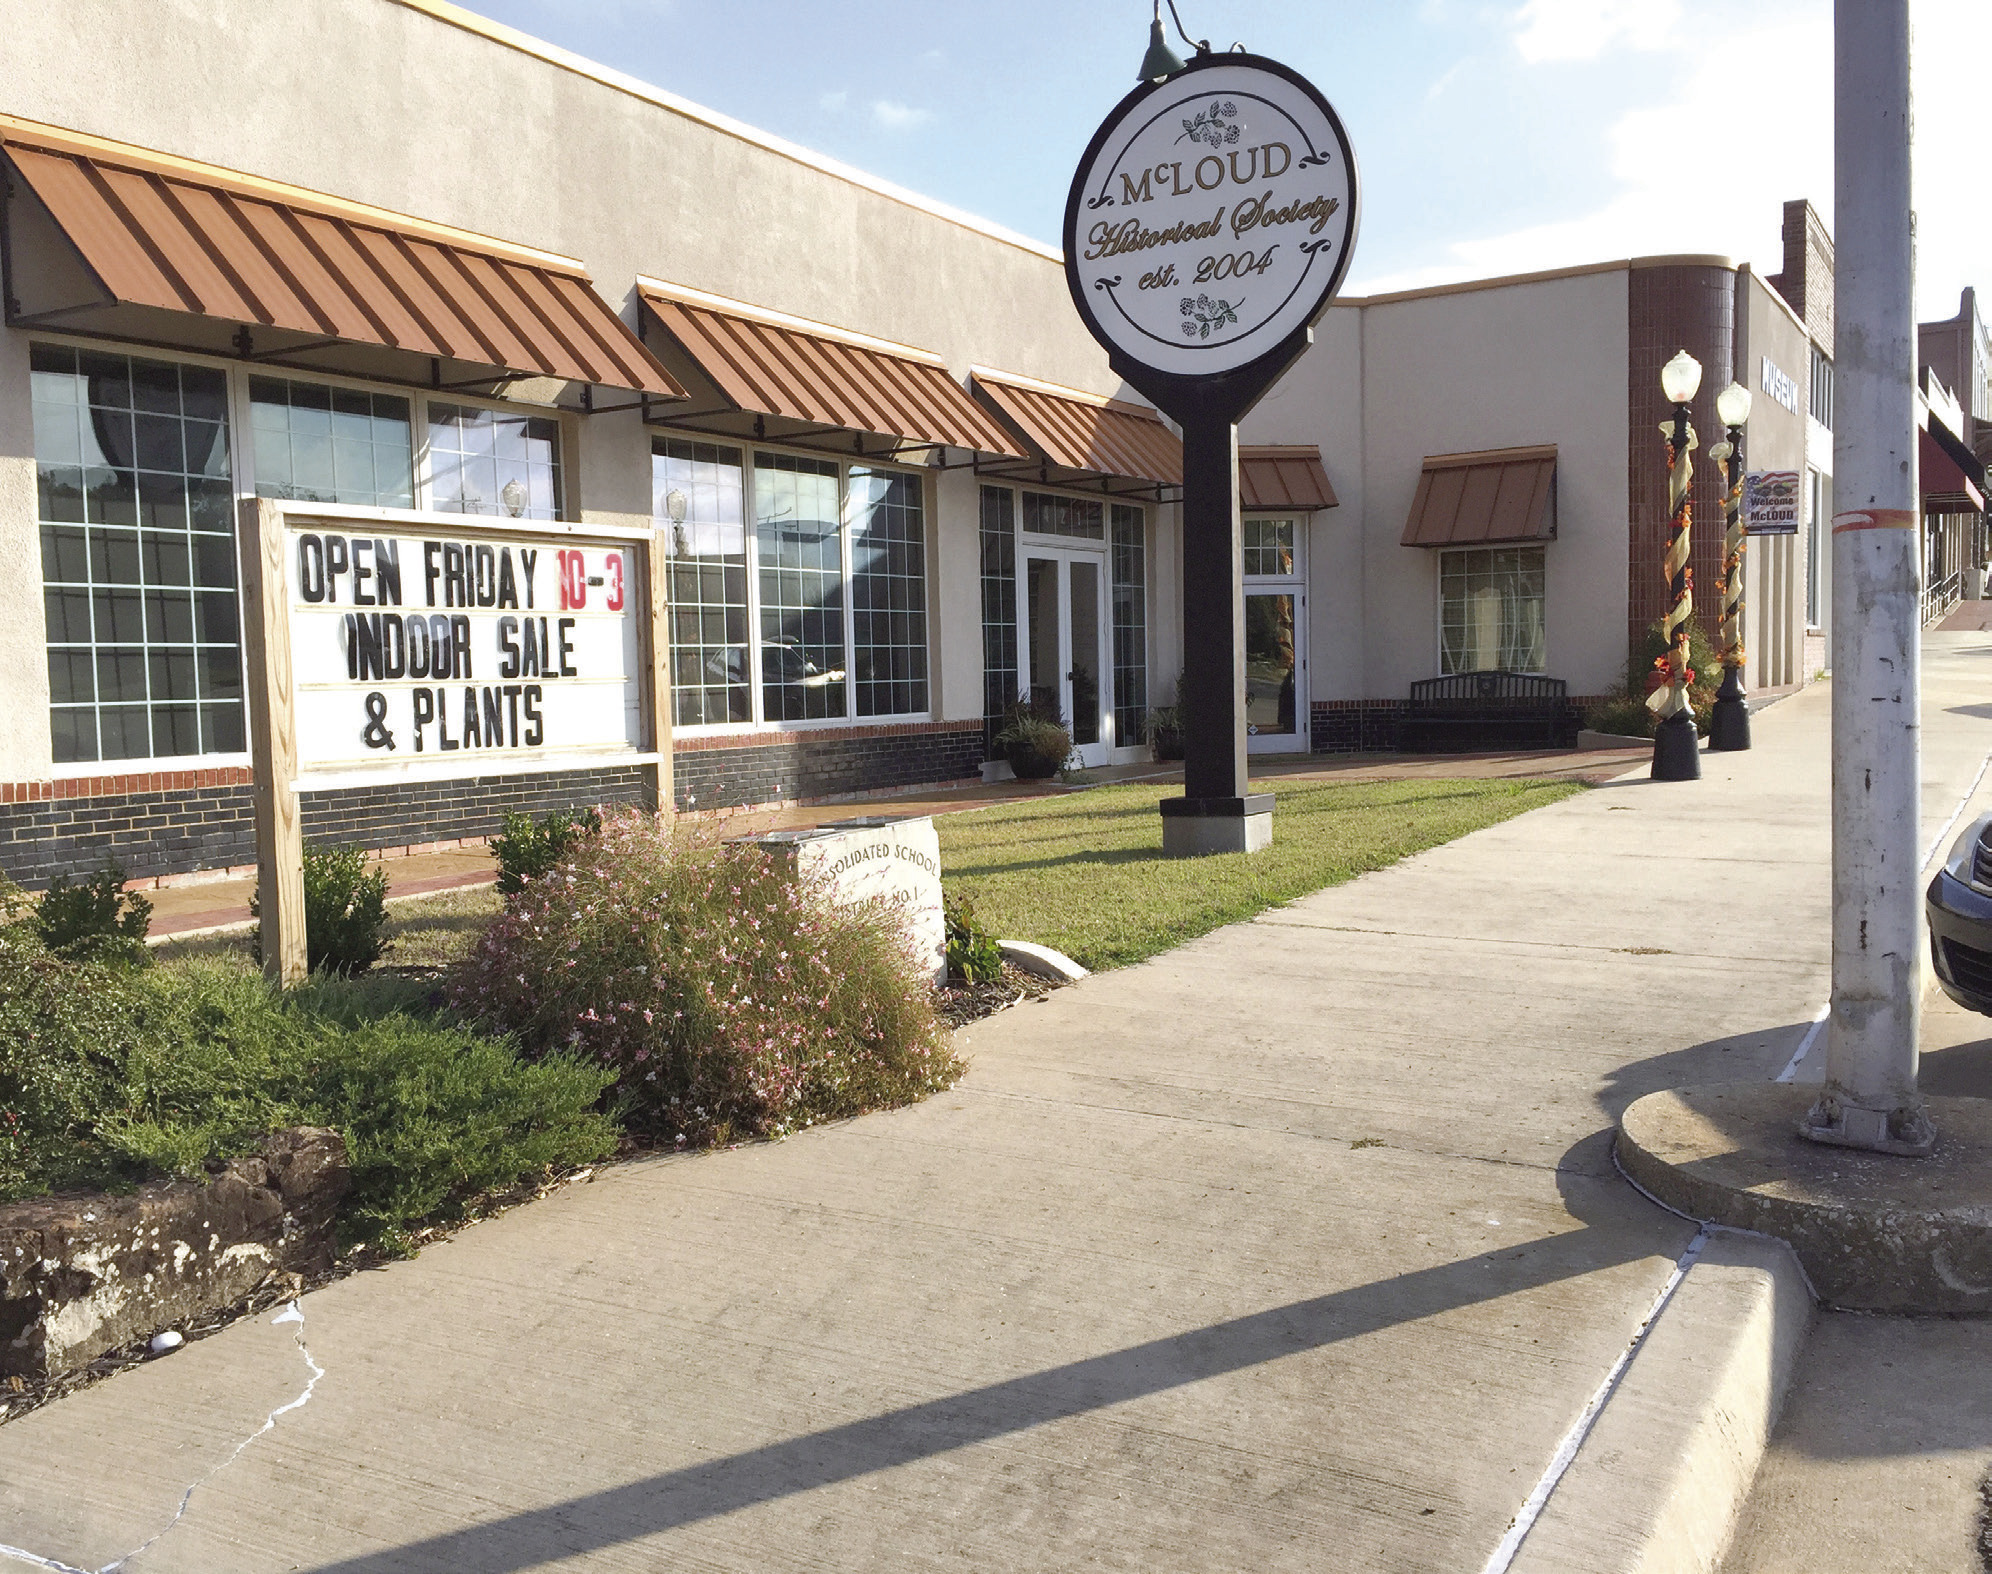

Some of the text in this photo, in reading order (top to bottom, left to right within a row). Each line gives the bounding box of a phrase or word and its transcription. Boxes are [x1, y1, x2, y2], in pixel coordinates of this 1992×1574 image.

[1119, 142, 1292, 206] McLOUD
[1084, 190, 1340, 260] Historical Society
[1138, 244, 1281, 291] est. 2004
[1760, 355, 1798, 416] MUSEUM
[1750, 497, 1794, 506] Welcome
[1750, 510, 1794, 521] McLOUD
[298, 533, 625, 612] OPEN FRIDAY 10-3
[344, 612, 578, 681] INDOOR SALE
[363, 684, 545, 752] & PLANTS
[893, 844, 937, 877] SCHOOL
